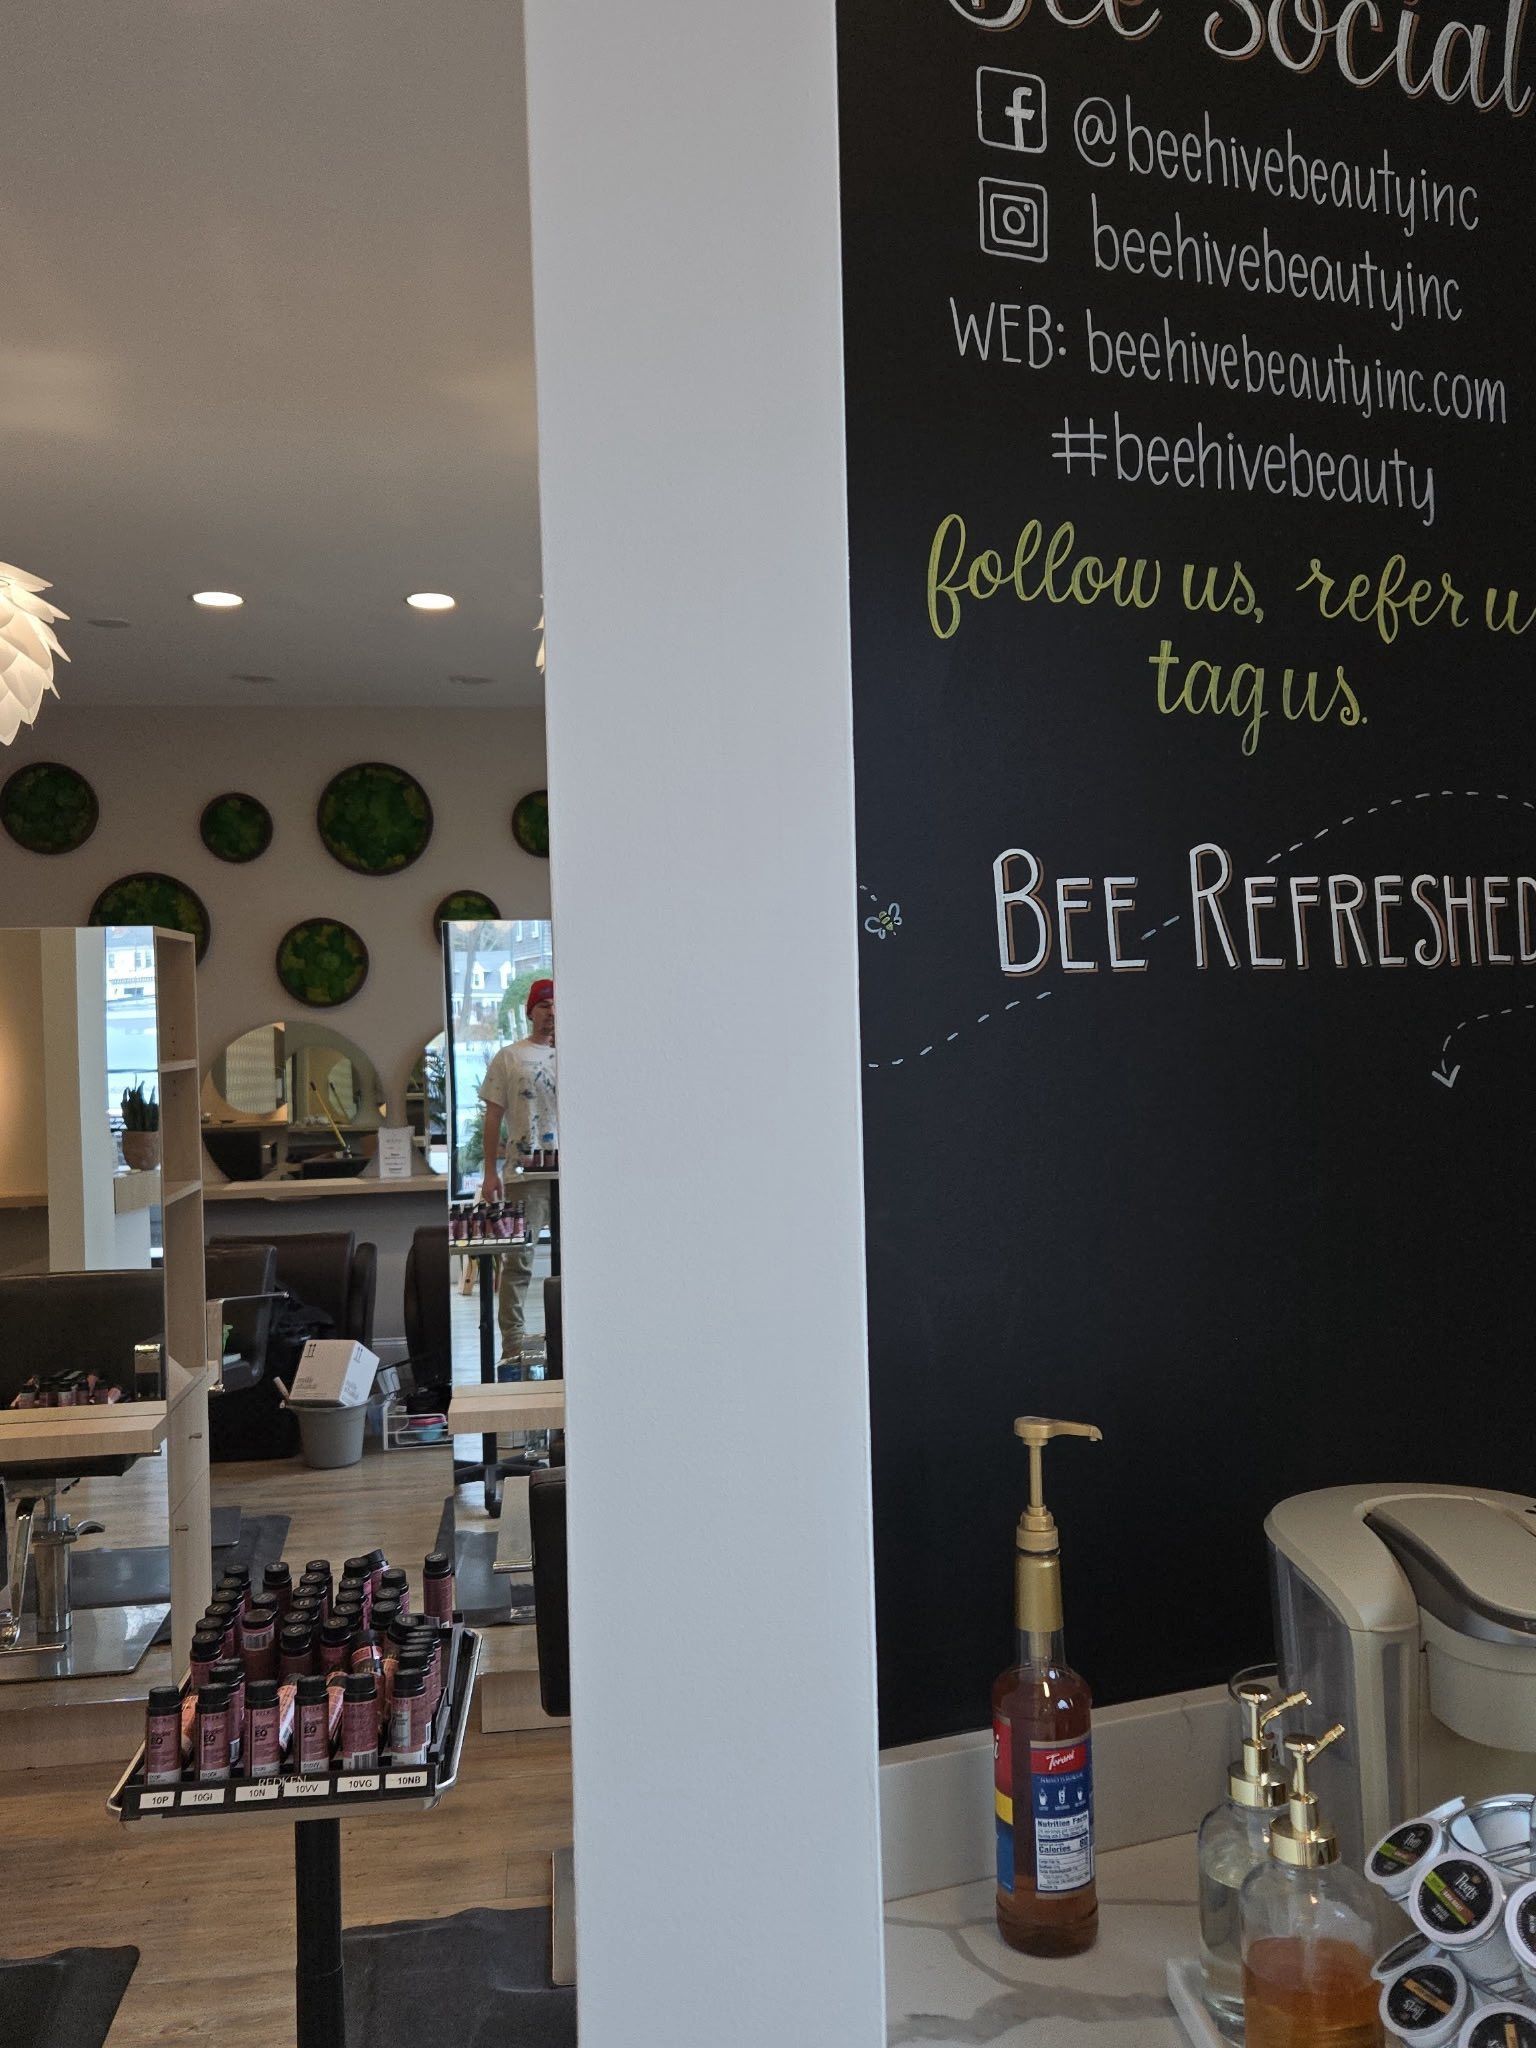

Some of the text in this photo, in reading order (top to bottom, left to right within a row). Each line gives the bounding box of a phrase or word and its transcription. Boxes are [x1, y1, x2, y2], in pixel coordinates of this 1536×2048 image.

[1073, 94, 1479, 237] @beehivebeautyinc
[1090, 192, 1463, 331] beehivebeautyinc
[949, 296, 1507, 424] WEB: beehivebeautyinc.com
[1051, 410, 1435, 527] #beehivebeauty
[927, 513, 1536, 645] follow us, refer u
[1148, 639, 1369, 757] tag us.
[151, 1796, 169, 1805] 10P
[249, 1788, 266, 1798] 10N
[295, 1784, 319, 1793] 10VV
[348, 1779, 373, 1789] 10VG
[397, 1775, 421, 1785] 10NB
